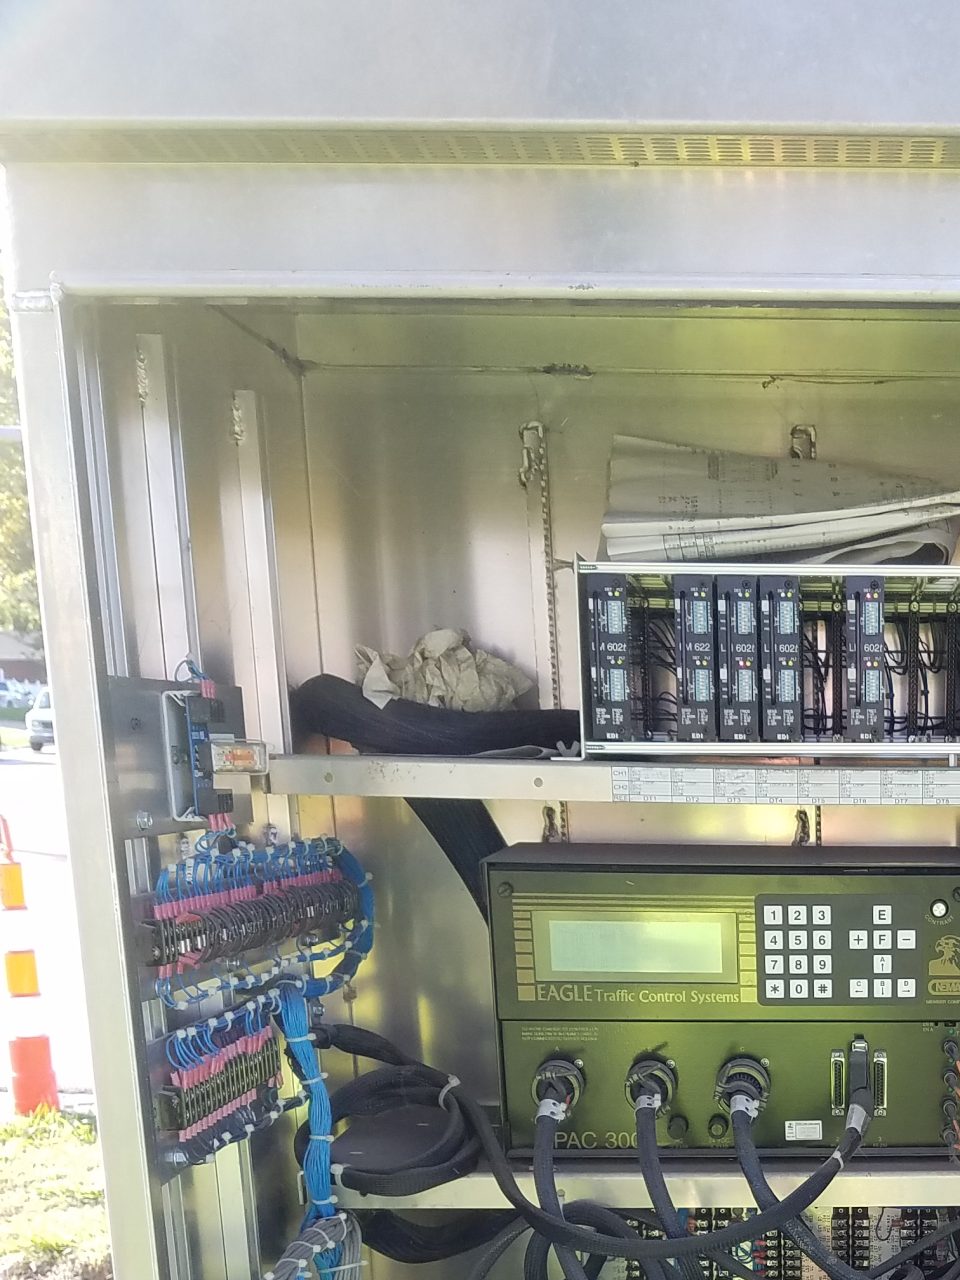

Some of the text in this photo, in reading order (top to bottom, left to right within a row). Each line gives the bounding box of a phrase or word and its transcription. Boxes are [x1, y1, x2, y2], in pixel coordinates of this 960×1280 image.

[607, 643, 626, 651] 602t
[694, 643, 710, 651] 622
[721, 643, 754, 652] L 602t
[764, 643, 798, 652] L 602t
[864, 644, 882, 652] 602t
[770, 911, 826, 920] 1 2 3
[878, 910, 886, 920] E
[924, 914, 954, 926] CONTRAST
[770, 936, 826, 945] 4 5 6
[878, 935, 886, 944] F
[770, 960, 826, 970] 7 8 9
[795, 984, 828, 994] 0 #
[537, 984, 739, 1004] EAGLE Traffic Control Systems
